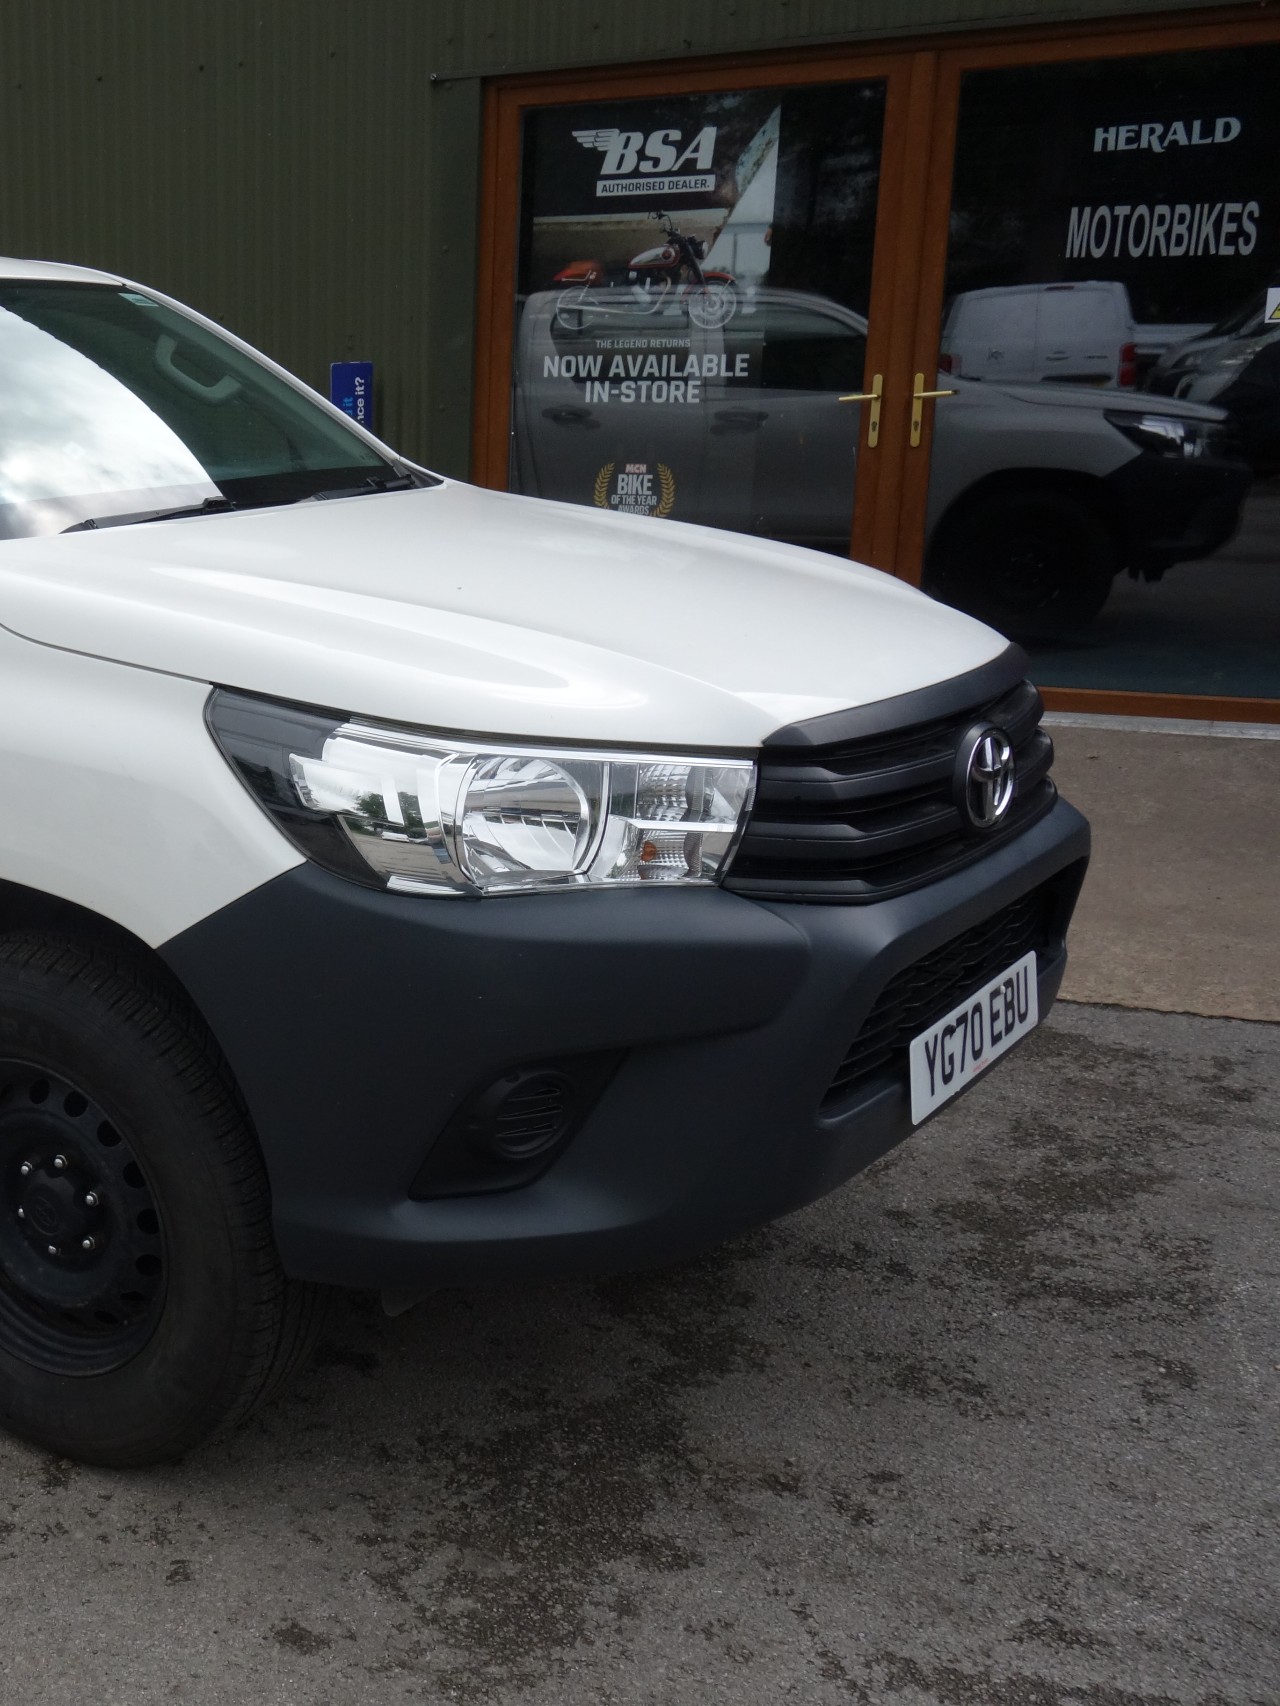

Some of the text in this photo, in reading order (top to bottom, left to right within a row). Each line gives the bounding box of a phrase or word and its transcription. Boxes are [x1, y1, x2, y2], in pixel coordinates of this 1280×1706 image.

[1093, 116, 1242, 153] HERALD
[600, 126, 718, 175] BSA
[601, 181, 665, 194] AUTHORISED
[1065, 201, 1260, 258] MOTORBIKES
[596, 338, 691, 349] THE LEGEND RETURNS
[543, 353, 750, 378] NOW AVAILABLE
[354, 376, 365, 395] it?
[585, 380, 701, 403] IN-STORE
[625, 464, 647, 474] MCN
[617, 474, 654, 495] BIKE
[611, 494, 658, 505] OF THE YEAR
[617, 505, 650, 516] AWARDS
[924, 965, 1029, 1097] YG70 EBU
